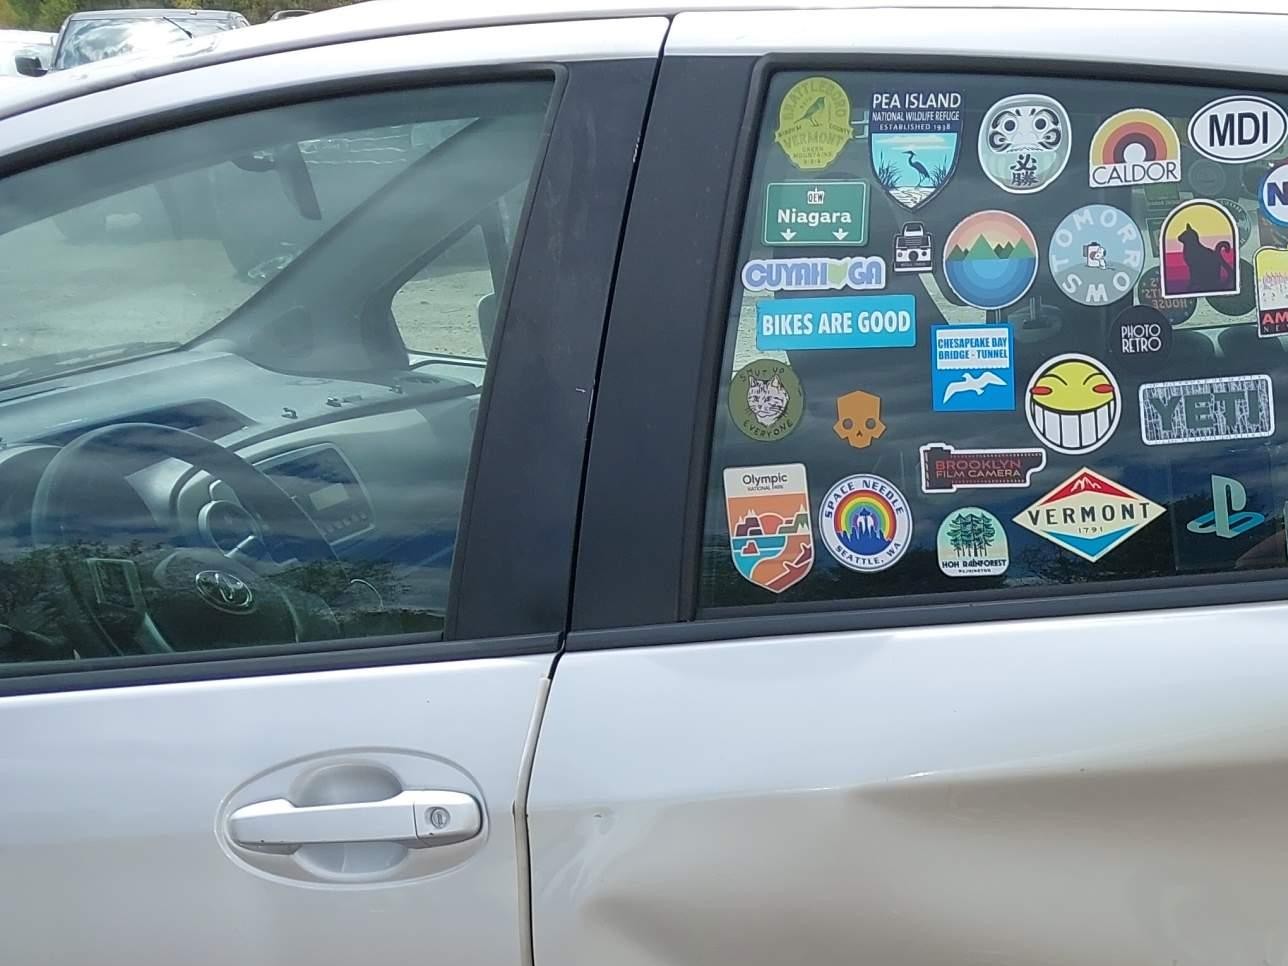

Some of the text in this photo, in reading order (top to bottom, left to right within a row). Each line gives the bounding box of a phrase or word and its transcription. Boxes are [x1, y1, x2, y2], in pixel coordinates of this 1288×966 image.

[872, 92, 961, 109] PEA ISLAND
[872, 110, 960, 122] NATIONAL WILDLIFE REFUGE
[879, 123, 951, 131] ESTABLISHED 1938
[1209, 111, 1269, 147] MDI
[1092, 163, 1178, 185] CALDOR
[777, 208, 852, 227] Niagara
[762, 311, 910, 336] BIKES ARE GOOD
[1121, 324, 1161, 338] PHOTO
[938, 337, 1008, 349] CHESAPEAKE BAY
[1121, 337, 1162, 353] RETRO
[938, 350, 970, 360] BRIDGE
[977, 349, 1008, 359] TUNNEL
[1149, 389, 1261, 431] YETI
[743, 419, 793, 437] EVERYONE
[936, 459, 1021, 470] BROOKLYN
[742, 472, 788, 486] Olympic
[936, 469, 1021, 478] FILM CAMERA
[825, 480, 904, 518] SPACE NEEDLE
[1028, 502, 1150, 526] VERMONT
[836, 542, 901, 565] SEATTLE, WA
[942, 560, 960, 568] HOH
